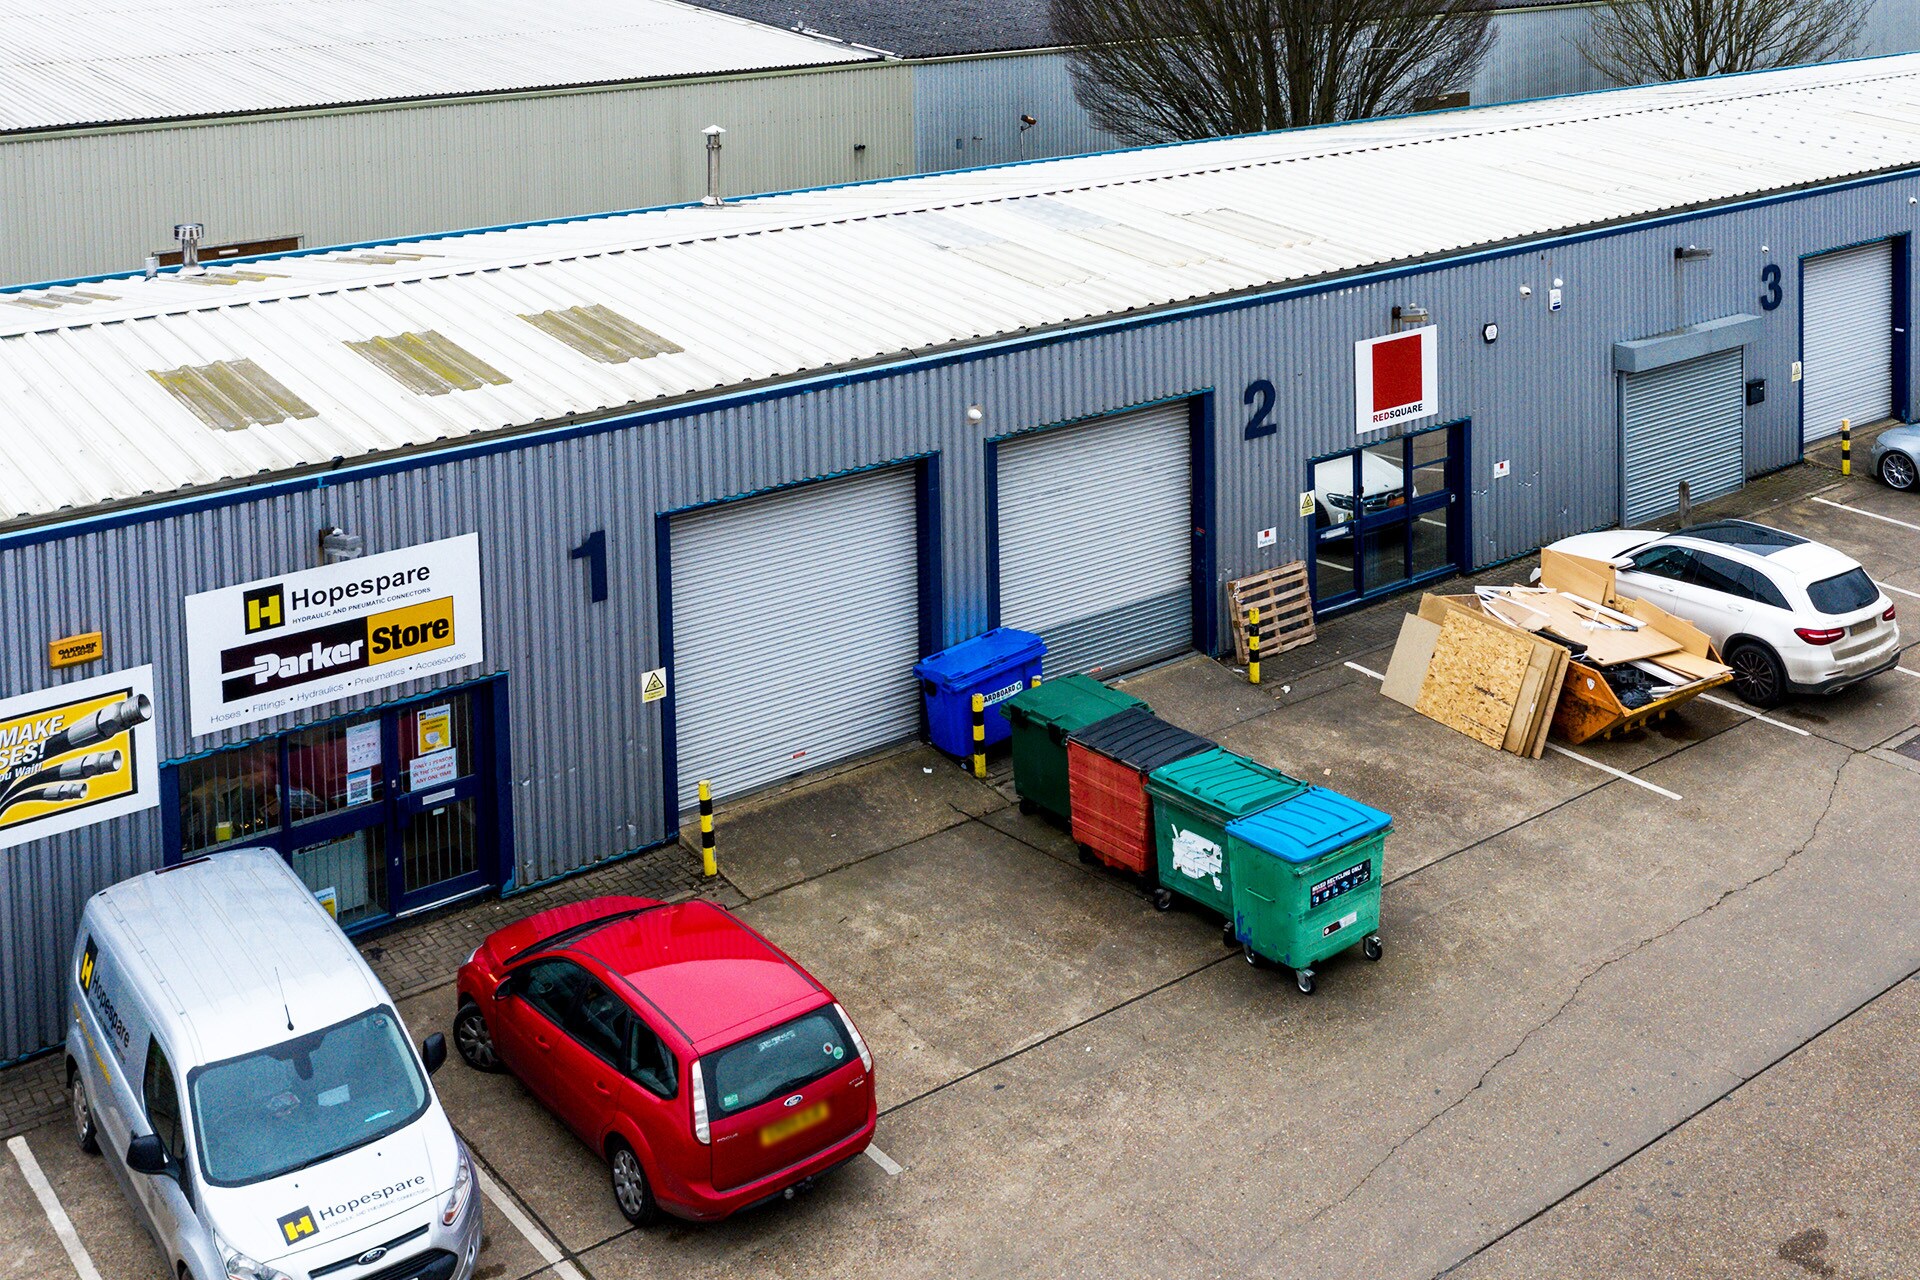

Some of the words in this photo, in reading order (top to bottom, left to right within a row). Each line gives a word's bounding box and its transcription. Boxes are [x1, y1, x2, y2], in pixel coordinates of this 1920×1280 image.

[1761, 264, 1783, 311] 3
[1244, 379, 1277, 441] 2
[1372, 403, 1423, 423] REDSQUARE
[291, 566, 431, 611] Hopespare
[571, 530, 608, 603] 1
[292, 611, 331, 624] HYDRAULIC
[333, 607, 347, 615] AND
[348, 598, 386, 611] PNEUMATIC
[387, 587, 431, 602] CONNECTORS
[58, 641, 97, 656] OAKPARK
[254, 639, 364, 685] Parker
[371, 618, 450, 655] Store
[210, 710, 241, 723] Hoses
[252, 698, 286, 712] Fittings
[297, 683, 344, 702] Hydraulics
[354, 668, 406, 687] Pneumatics
[415, 652, 467, 671] Accessories
[984, 685, 1015, 703] ARDBOARD
[0, 714, 65, 748] MAKE
[433, 756, 453, 765] PERSON
[92, 971, 130, 1048] Hopespare
[319, 1175, 426, 1221] Hopespare
